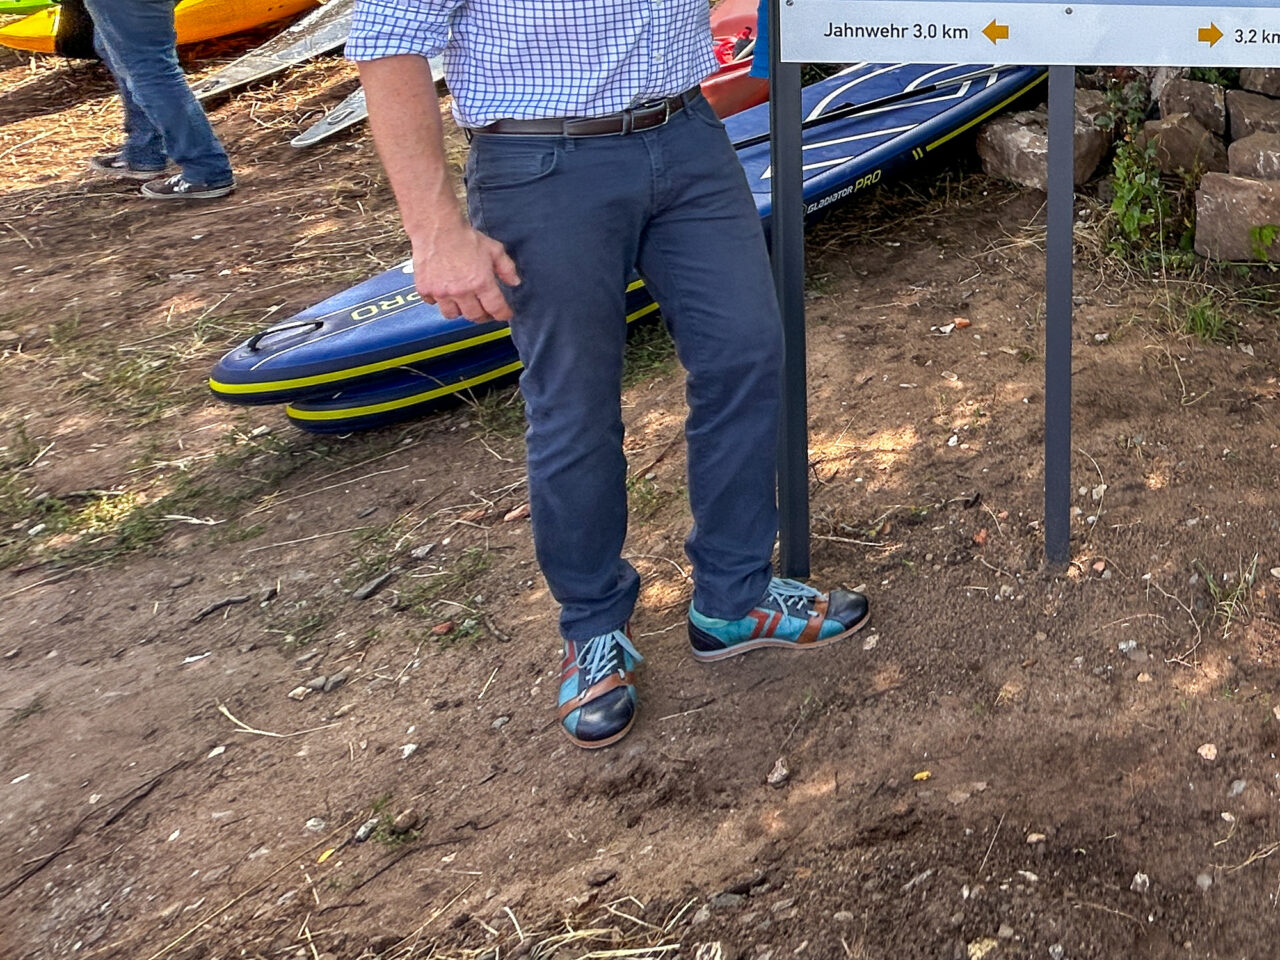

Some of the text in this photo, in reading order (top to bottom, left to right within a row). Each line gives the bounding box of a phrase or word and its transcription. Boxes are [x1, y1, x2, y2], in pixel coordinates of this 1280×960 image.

[824, 22, 969, 40] Jahnwehr 3,0 km
[1234, 29, 1258, 45] 3,2
[854, 169, 882, 192] PRO
